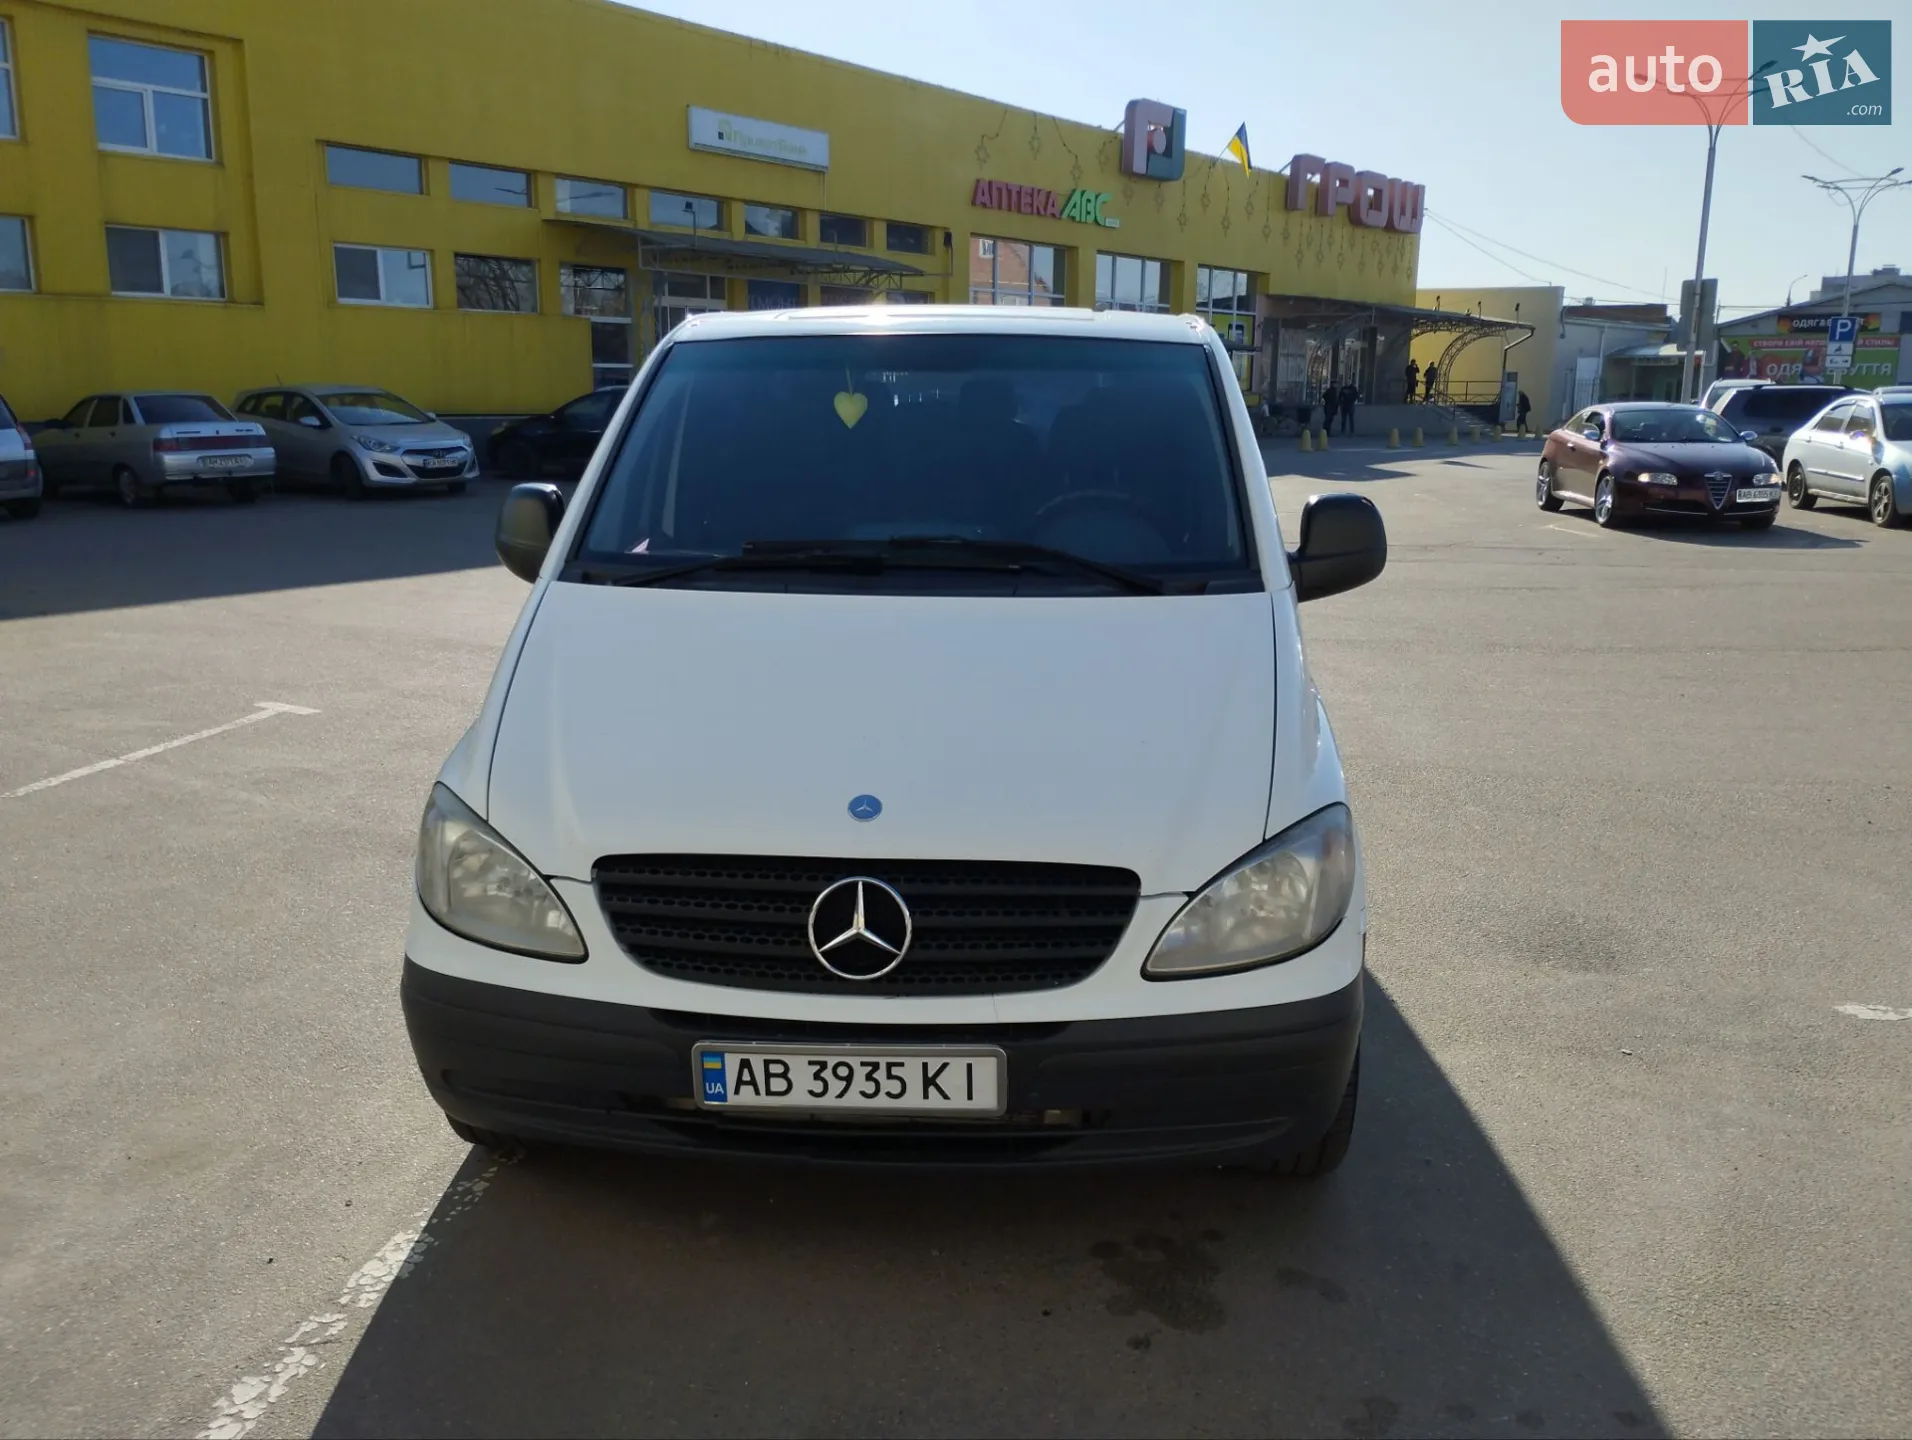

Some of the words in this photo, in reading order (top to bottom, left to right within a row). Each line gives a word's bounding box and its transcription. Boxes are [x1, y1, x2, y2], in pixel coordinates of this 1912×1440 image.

[971, 178, 1062, 219] АПТЕКА
[1287, 153, 1426, 233] ГРОШ
[1835, 319, 1852, 340] P
[1766, 362, 1803, 377] ОДЯ
[705, 1083, 724, 1095] UA
[734, 1058, 793, 1097] AB
[807, 1060, 907, 1099] 3935
[922, 1061, 973, 1100] KI
